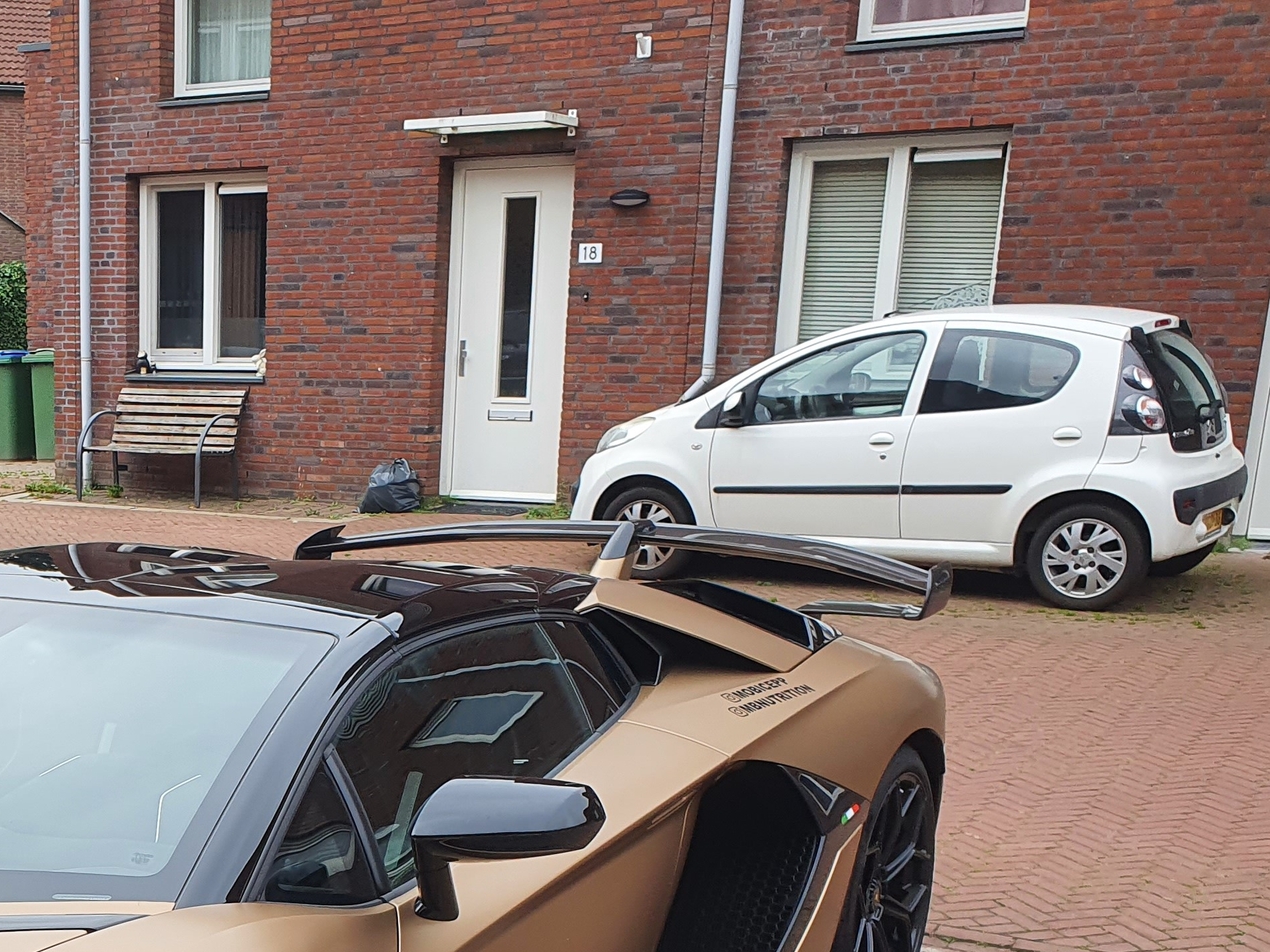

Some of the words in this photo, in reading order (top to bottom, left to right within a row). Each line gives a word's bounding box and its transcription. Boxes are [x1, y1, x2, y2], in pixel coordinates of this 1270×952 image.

[583, 246, 597, 260] 18
[731, 677, 789, 699] MOBICEPP
[738, 684, 816, 713] MBNUTRITION
